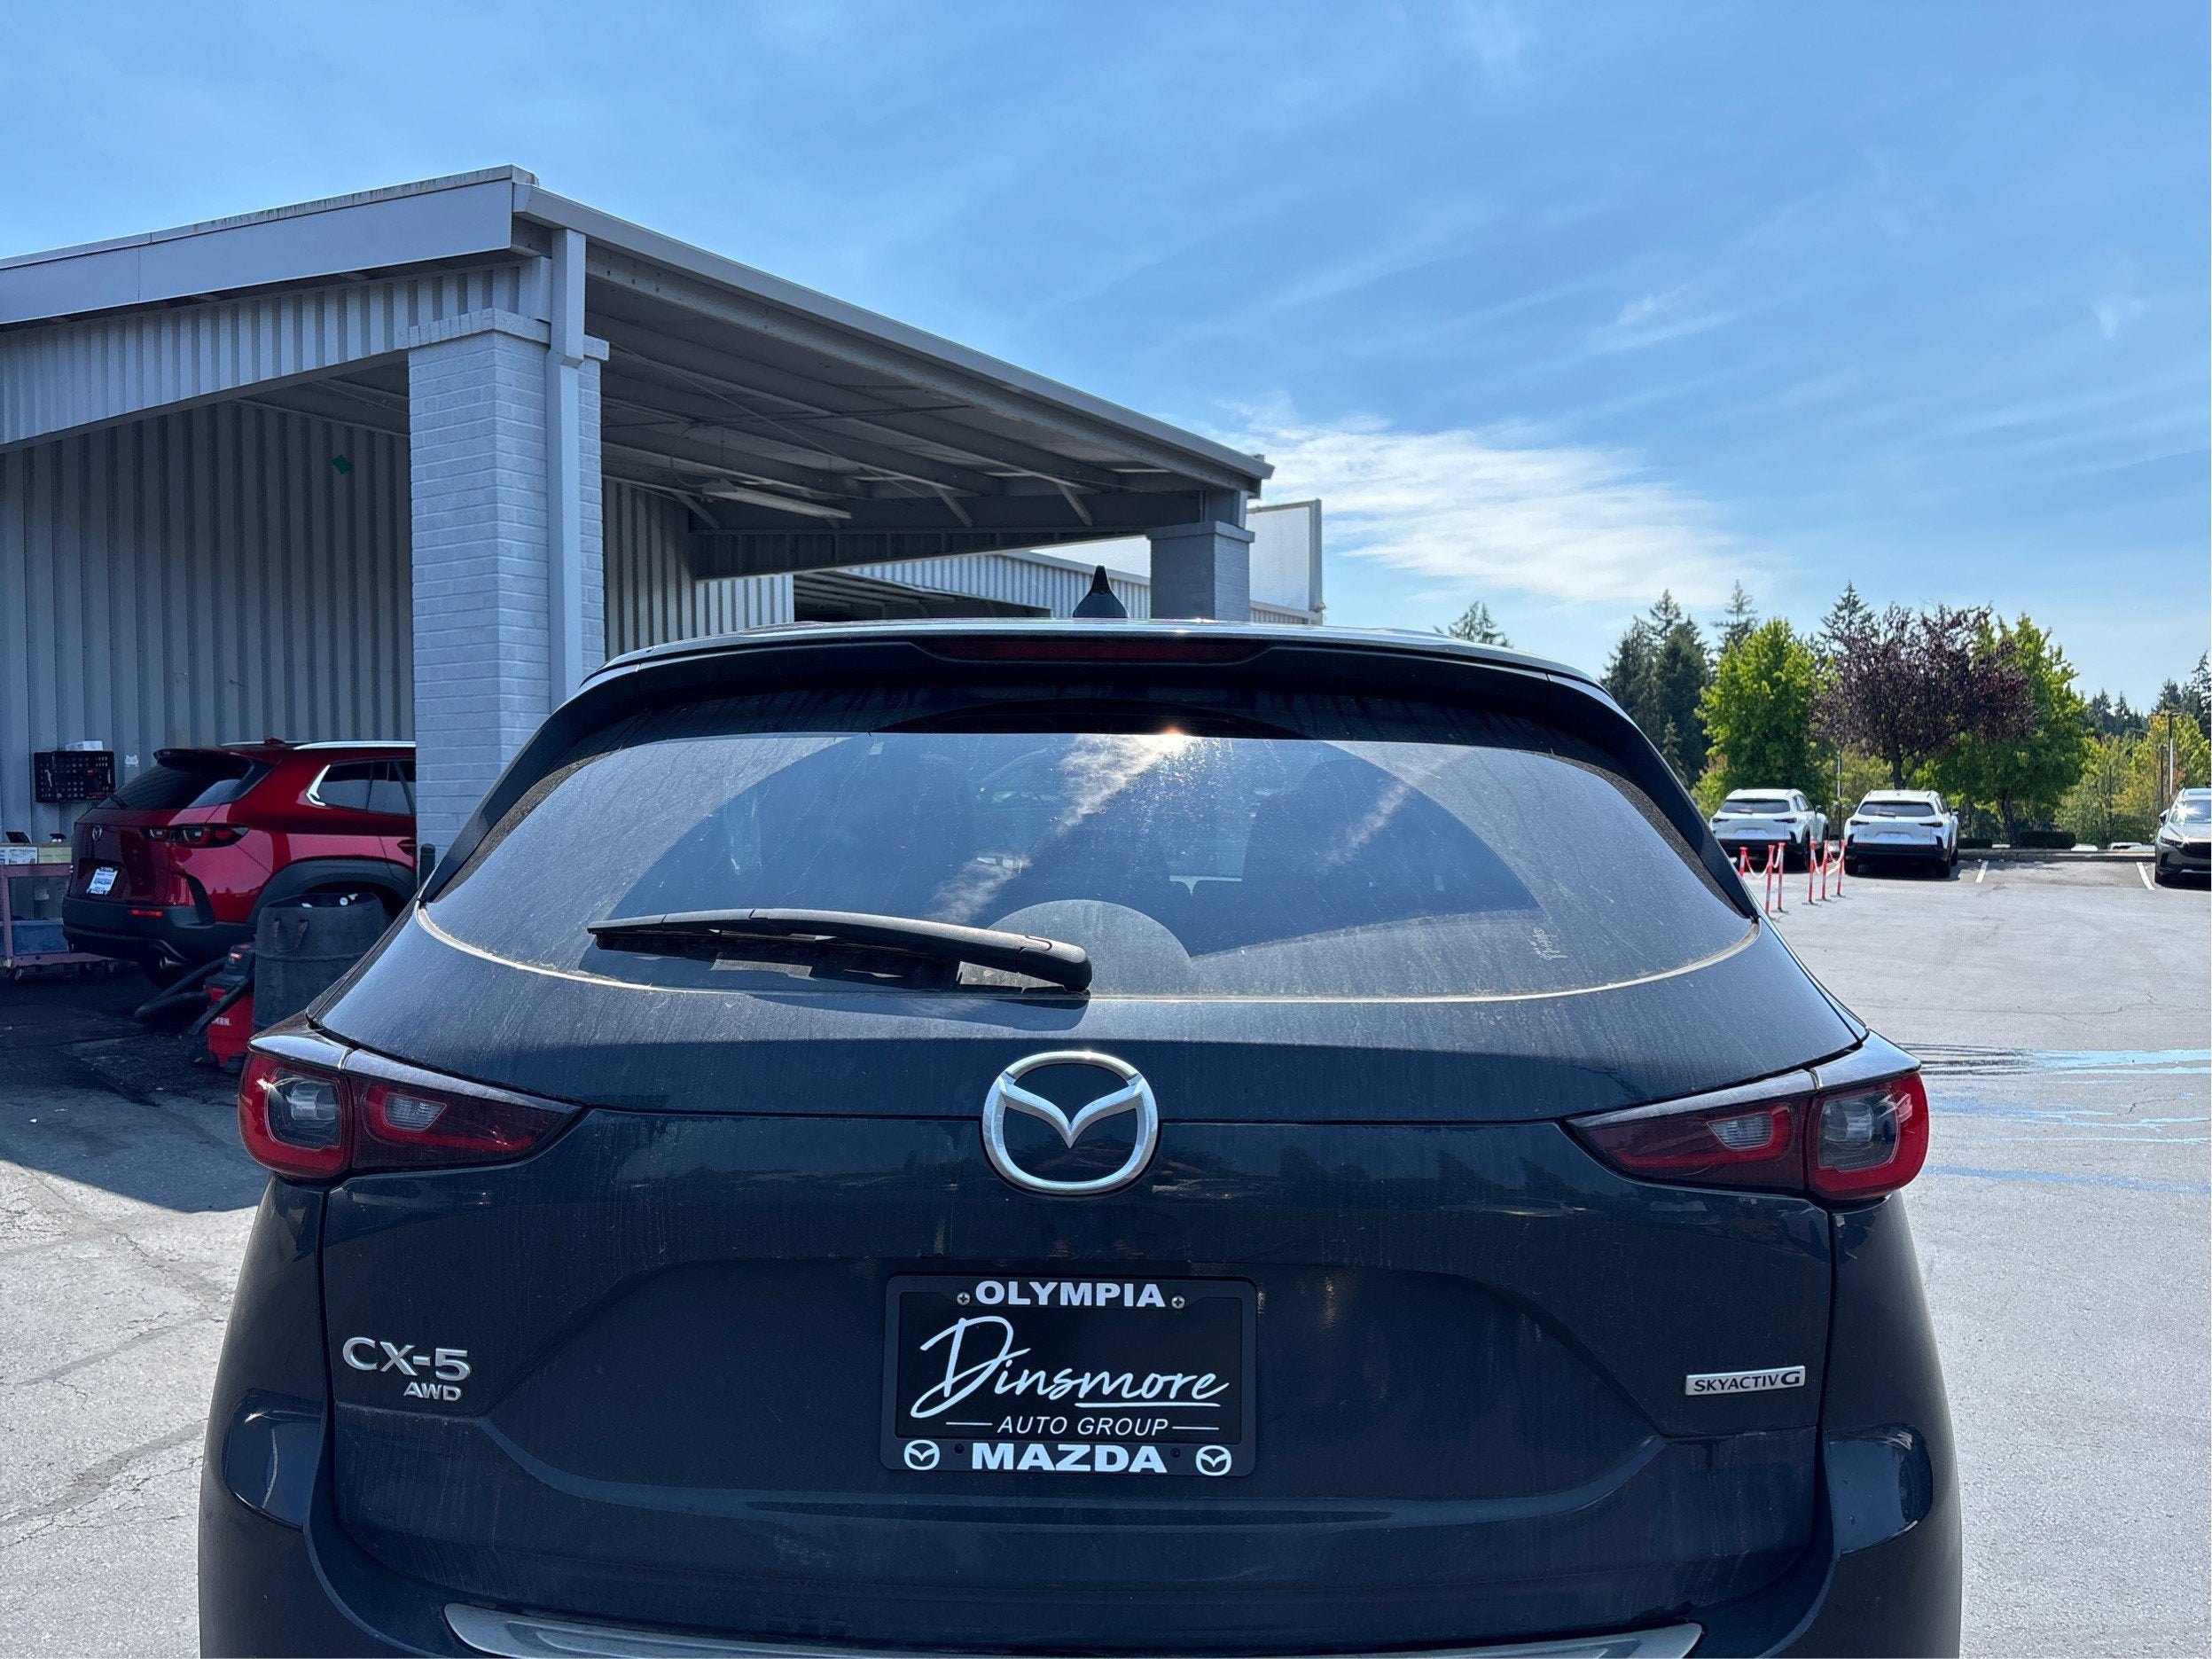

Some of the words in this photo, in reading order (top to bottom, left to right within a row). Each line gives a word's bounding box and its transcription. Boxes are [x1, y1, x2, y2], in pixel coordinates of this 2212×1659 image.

[975, 1280, 1166, 1308] OLYMPIA
[342, 1336, 471, 1381] CX-5
[910, 1316, 1230, 1419] Dinsmore
[403, 1381, 462, 1402] AWD
[997, 1415, 1067, 1435] AUTO
[1077, 1417, 1169, 1436] GROUP
[972, 1443, 1168, 1474] MAZDA
